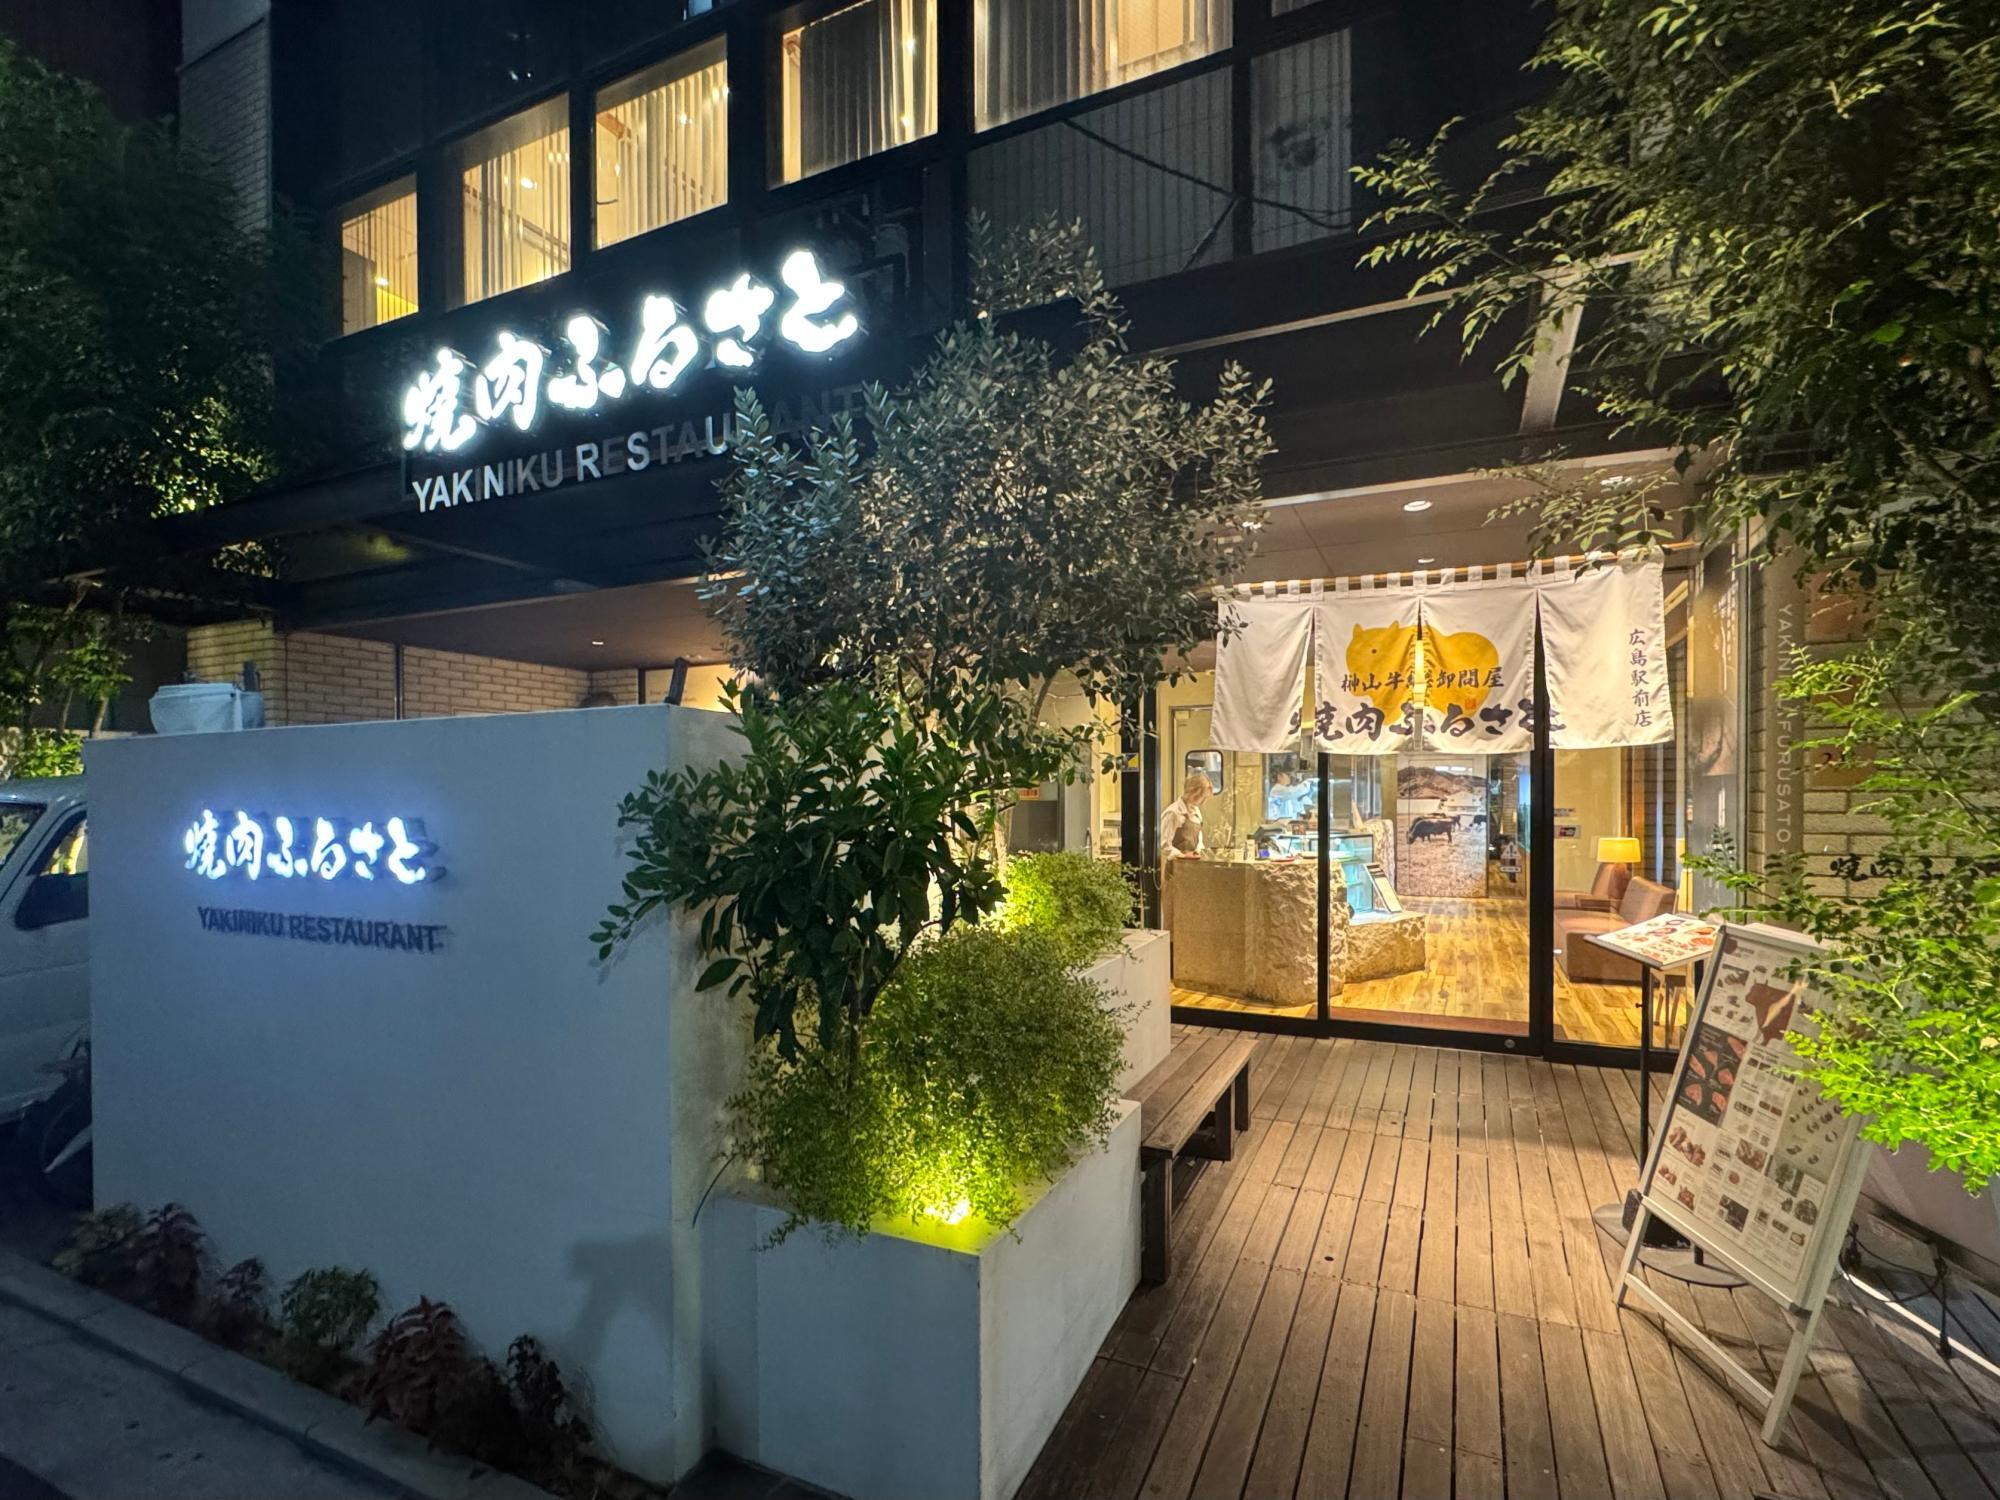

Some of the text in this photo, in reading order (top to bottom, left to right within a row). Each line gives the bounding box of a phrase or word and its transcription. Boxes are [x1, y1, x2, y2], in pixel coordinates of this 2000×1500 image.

[403, 248, 859, 453] 焼肉ふるさと
[412, 448, 564, 513] YAKINIKU
[1629, 628, 1653, 728] 広島駅前店
[1776, 603, 1793, 843] YAKINIU FURUSATO
[184, 809, 427, 884] 焼肉ふるさと
[198, 906, 442, 954] YAKINIKU RESTAURANT
